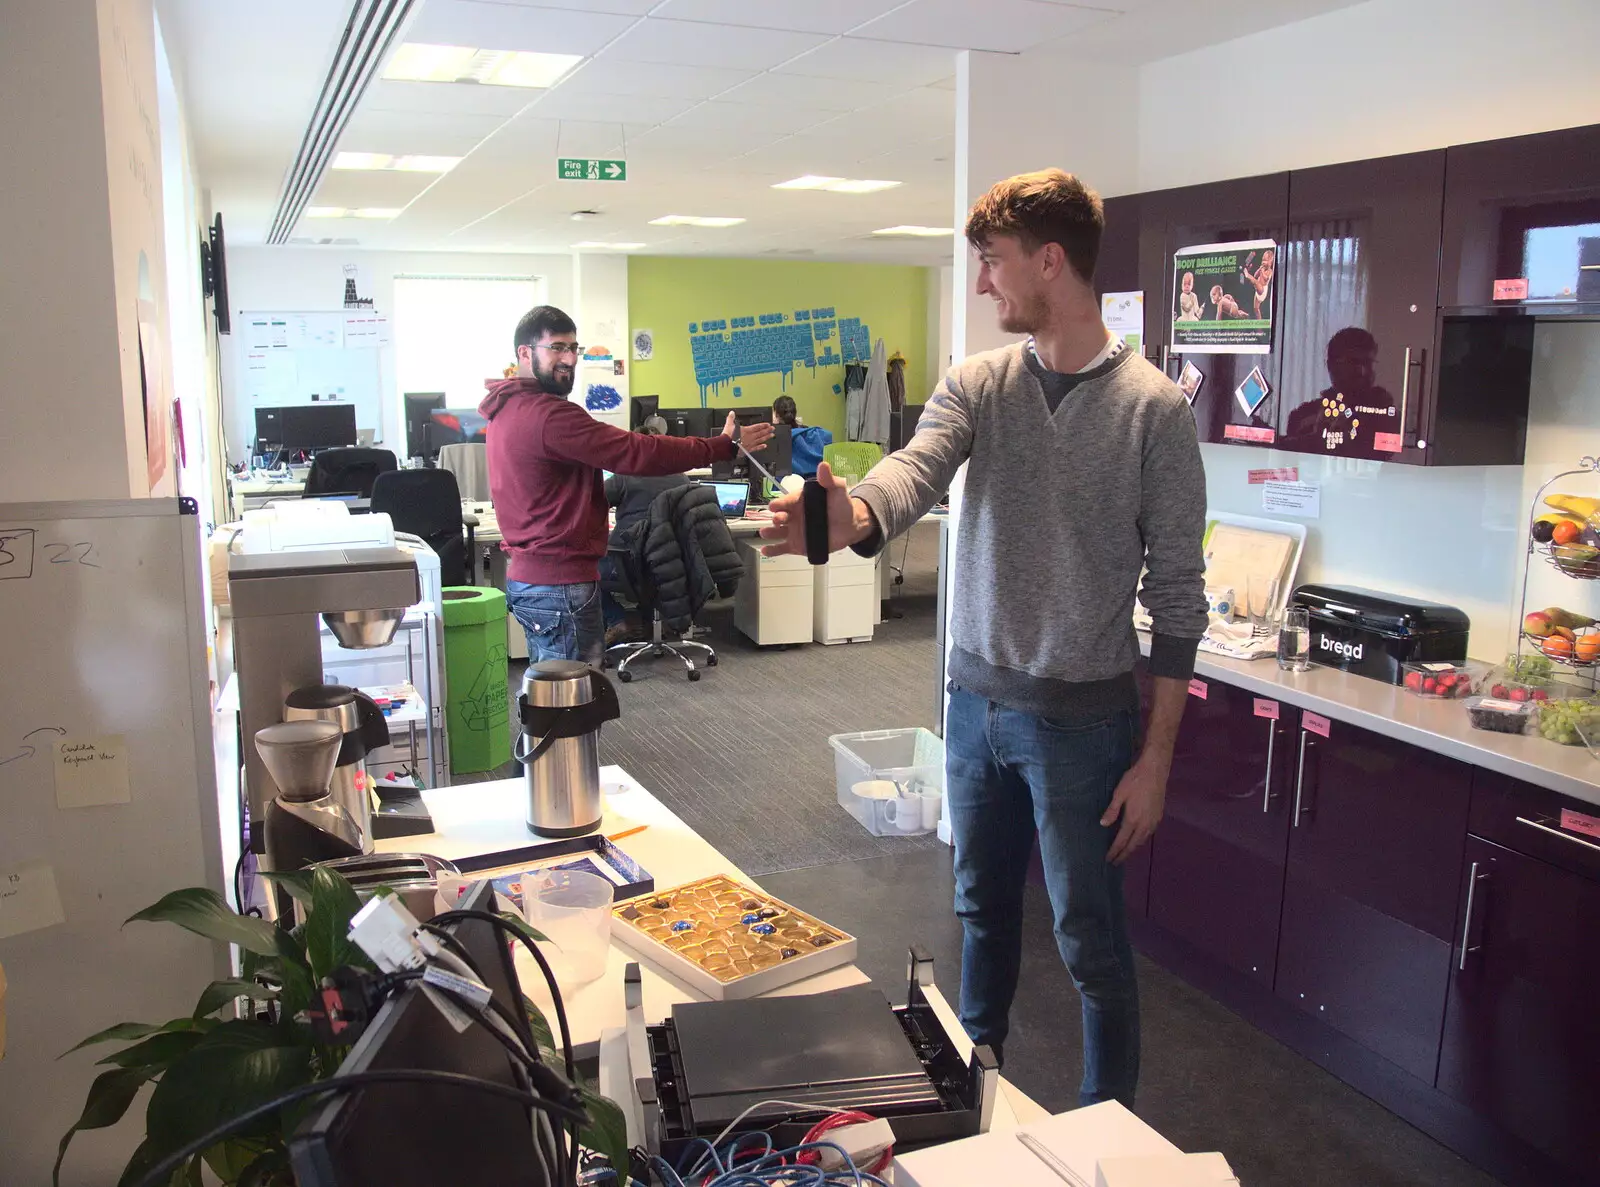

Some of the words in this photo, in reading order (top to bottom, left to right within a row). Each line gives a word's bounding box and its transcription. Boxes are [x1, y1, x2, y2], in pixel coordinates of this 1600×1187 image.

[564, 160, 582, 170] Fire
[564, 169, 582, 178] exit
[1176, 258, 1196, 270] BODY
[1196, 255, 1237, 268] BRILLIANCE
[43, 541, 103, 569] 22
[1320, 633, 1363, 660] bread
